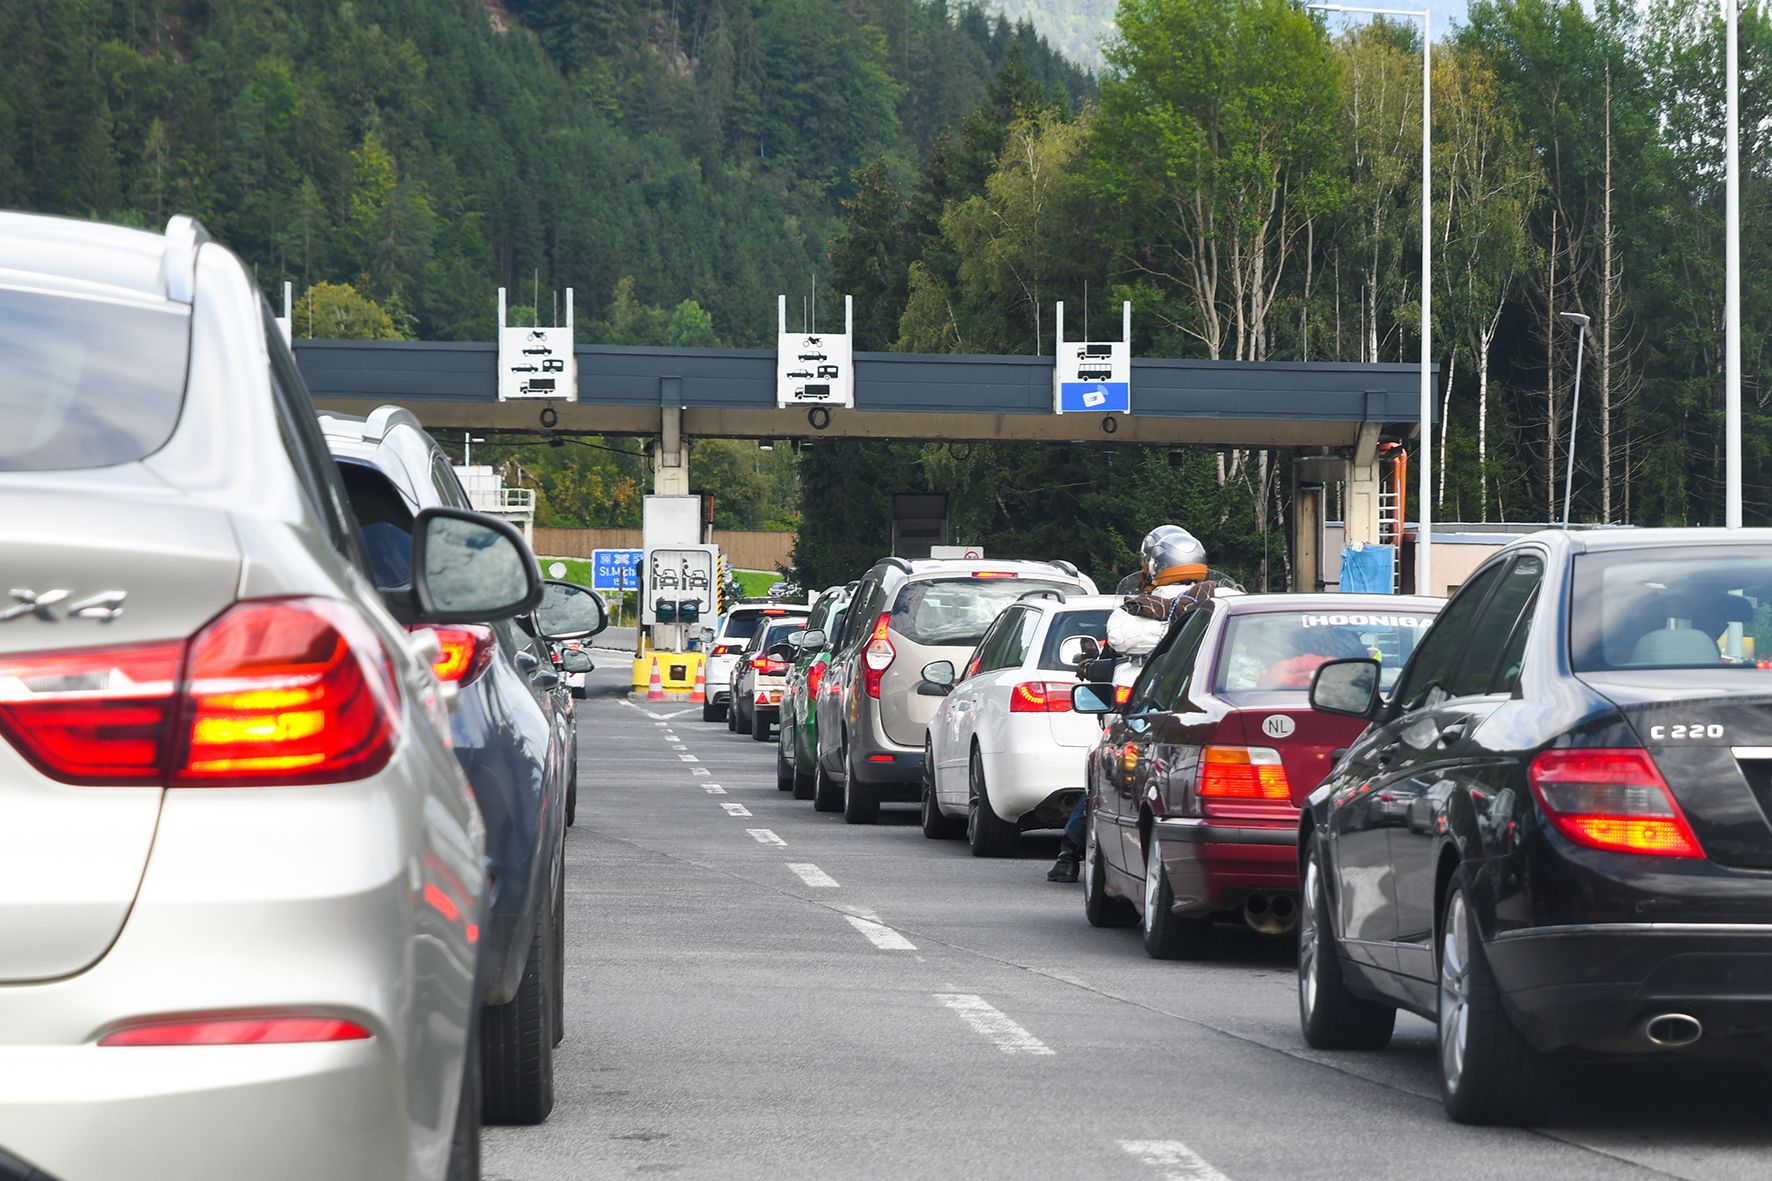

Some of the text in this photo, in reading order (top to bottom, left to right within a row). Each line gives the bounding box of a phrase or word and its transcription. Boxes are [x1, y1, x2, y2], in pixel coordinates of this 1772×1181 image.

[1268, 719, 1288, 733] NL
[1650, 724, 1724, 740] C 220
